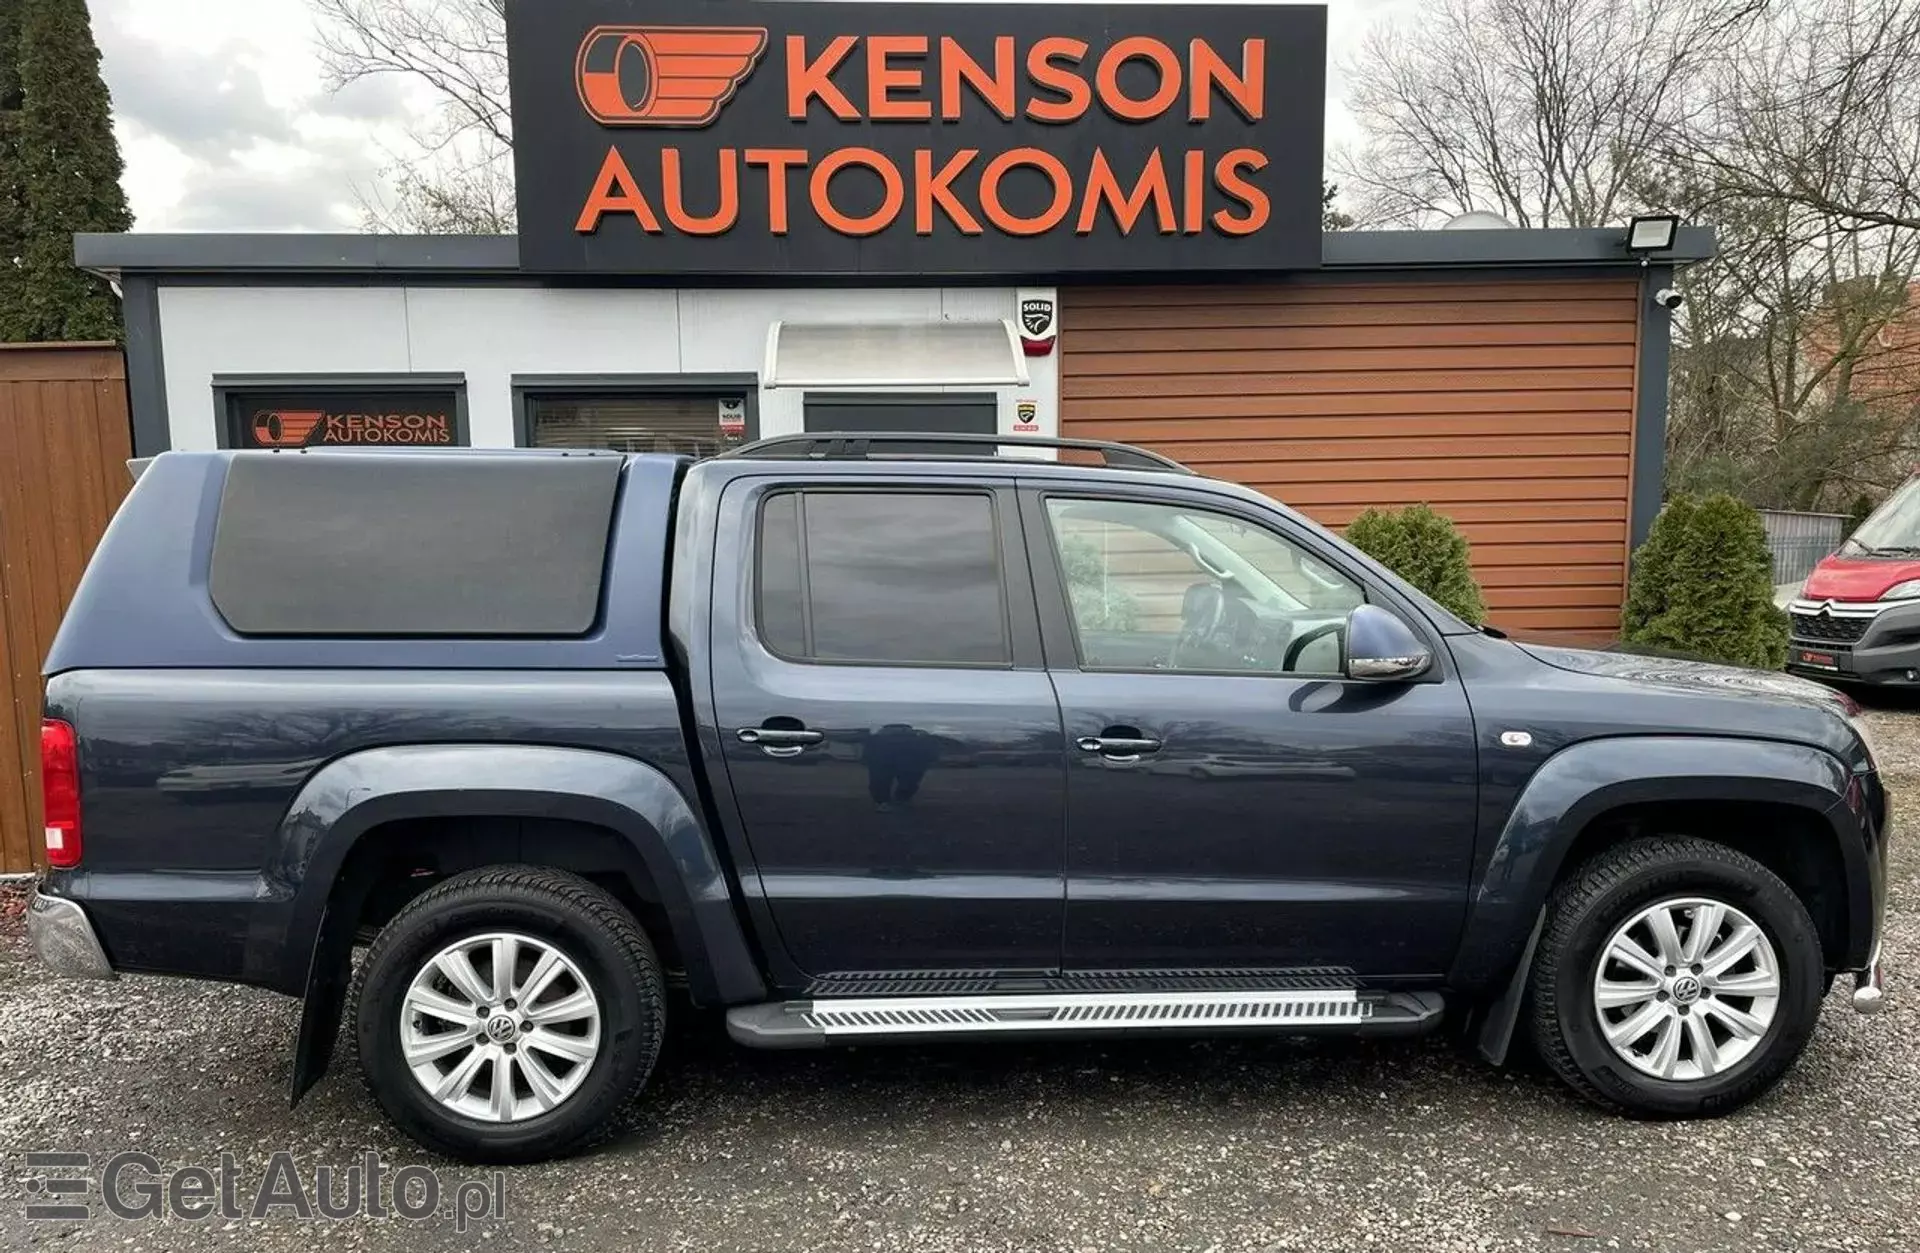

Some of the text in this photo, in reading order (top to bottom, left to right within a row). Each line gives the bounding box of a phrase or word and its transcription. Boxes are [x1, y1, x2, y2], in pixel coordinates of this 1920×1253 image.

[786, 36, 1265, 121] KENSON
[574, 147, 1271, 236] AUTOKOMIS
[1023, 303, 1051, 312] SOLID
[326, 415, 446, 428] KENSON
[323, 428, 450, 442] AUTOKOMIS
